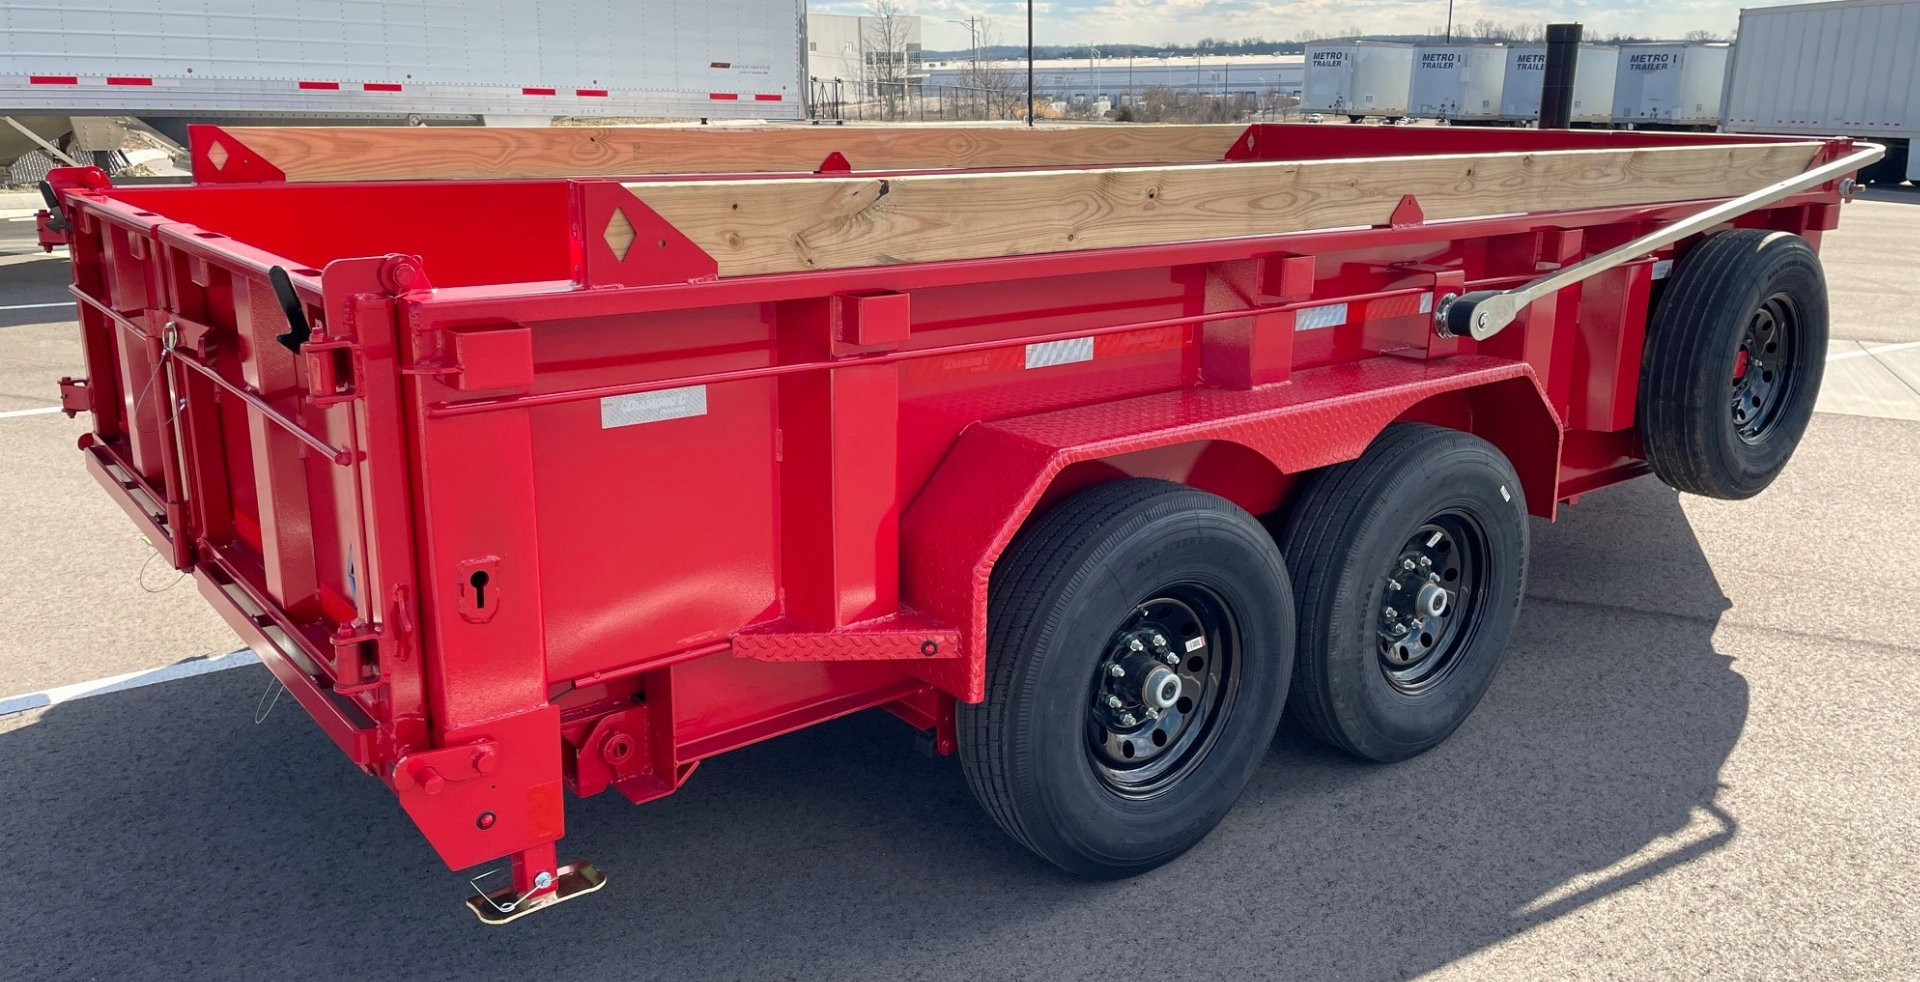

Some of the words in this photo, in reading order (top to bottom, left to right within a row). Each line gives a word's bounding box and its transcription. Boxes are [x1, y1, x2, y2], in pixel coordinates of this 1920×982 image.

[1313, 52, 1342, 60] METRO
[1422, 53, 1455, 61] METRO
[1517, 54, 1545, 62] METR
[1630, 54, 1669, 62] METRO
[1630, 62, 1668, 70] TRAILER
